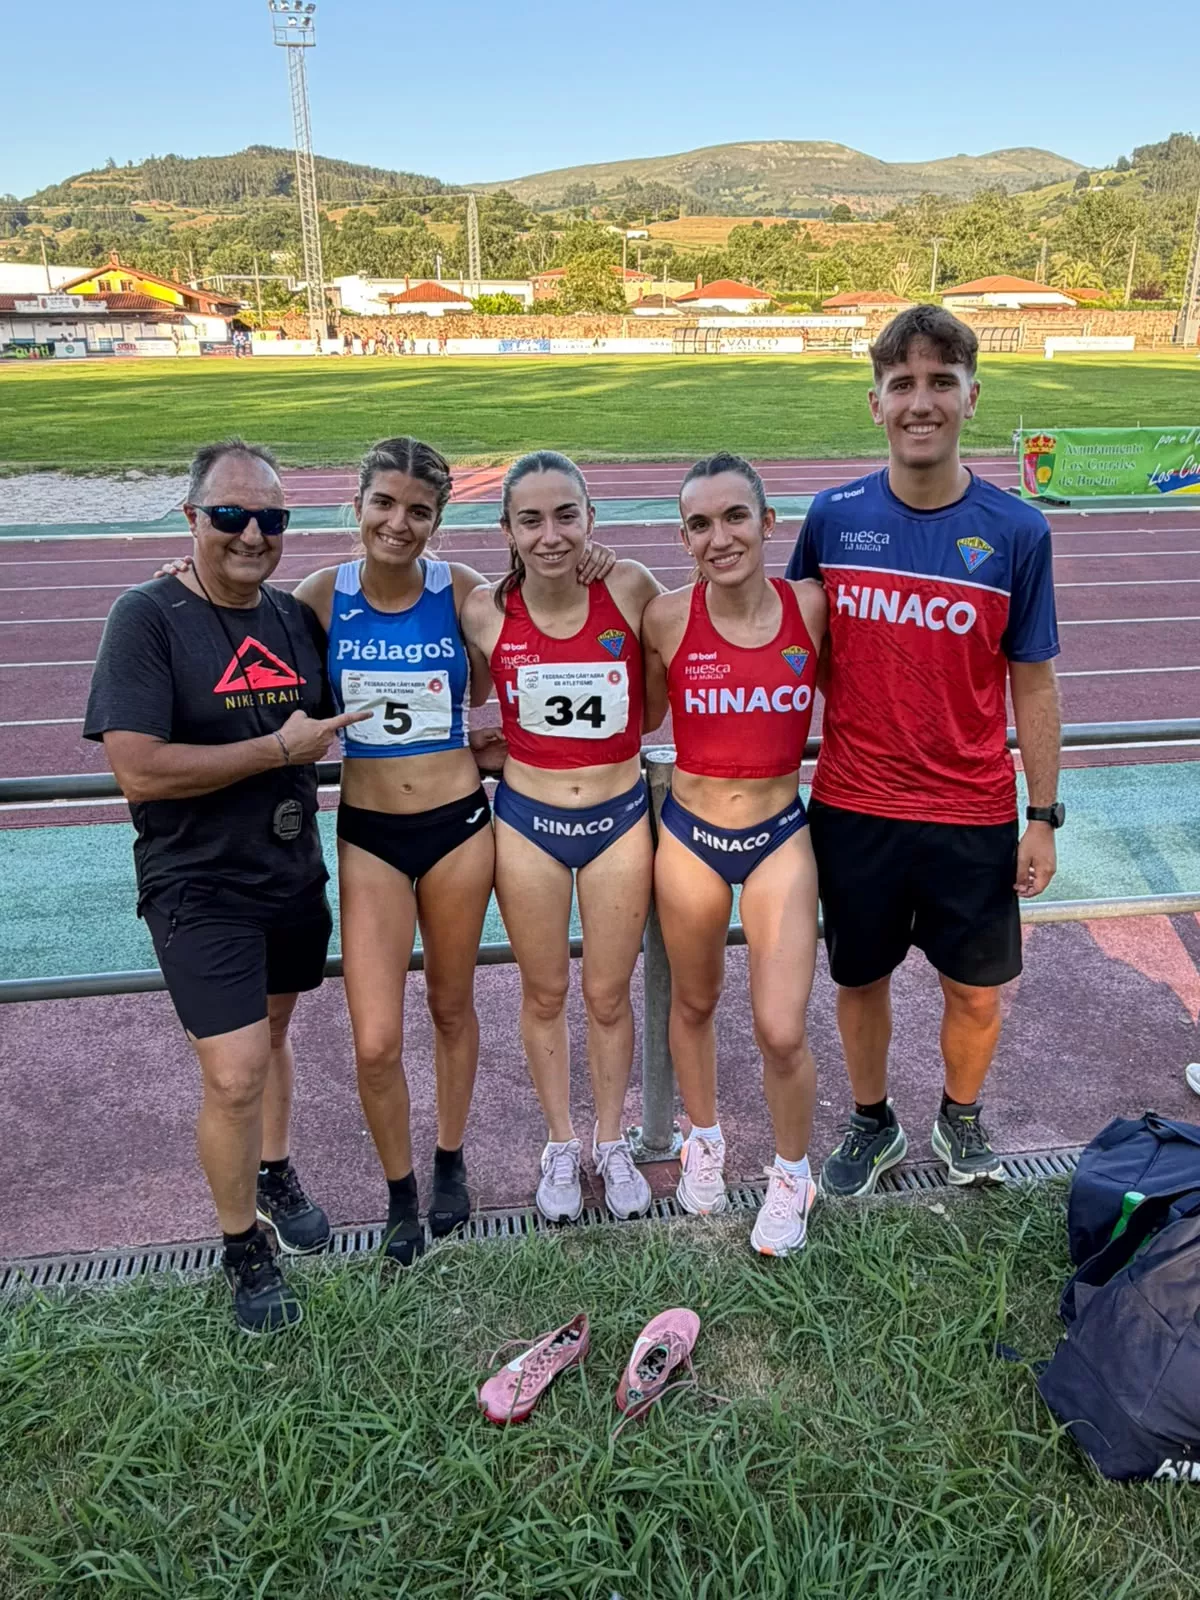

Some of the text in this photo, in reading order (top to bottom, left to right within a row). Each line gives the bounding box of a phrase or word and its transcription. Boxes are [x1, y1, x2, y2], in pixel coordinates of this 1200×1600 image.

[727, 338, 779, 346] VALCO
[1148, 463, 1175, 486] Los
[836, 584, 977, 635] HINACO
[544, 695, 606, 728] 34
[685, 684, 812, 714] HINACO
[383, 701, 412, 735] 5
[533, 816, 614, 836] HINACO
[692, 825, 770, 852] HINACO
